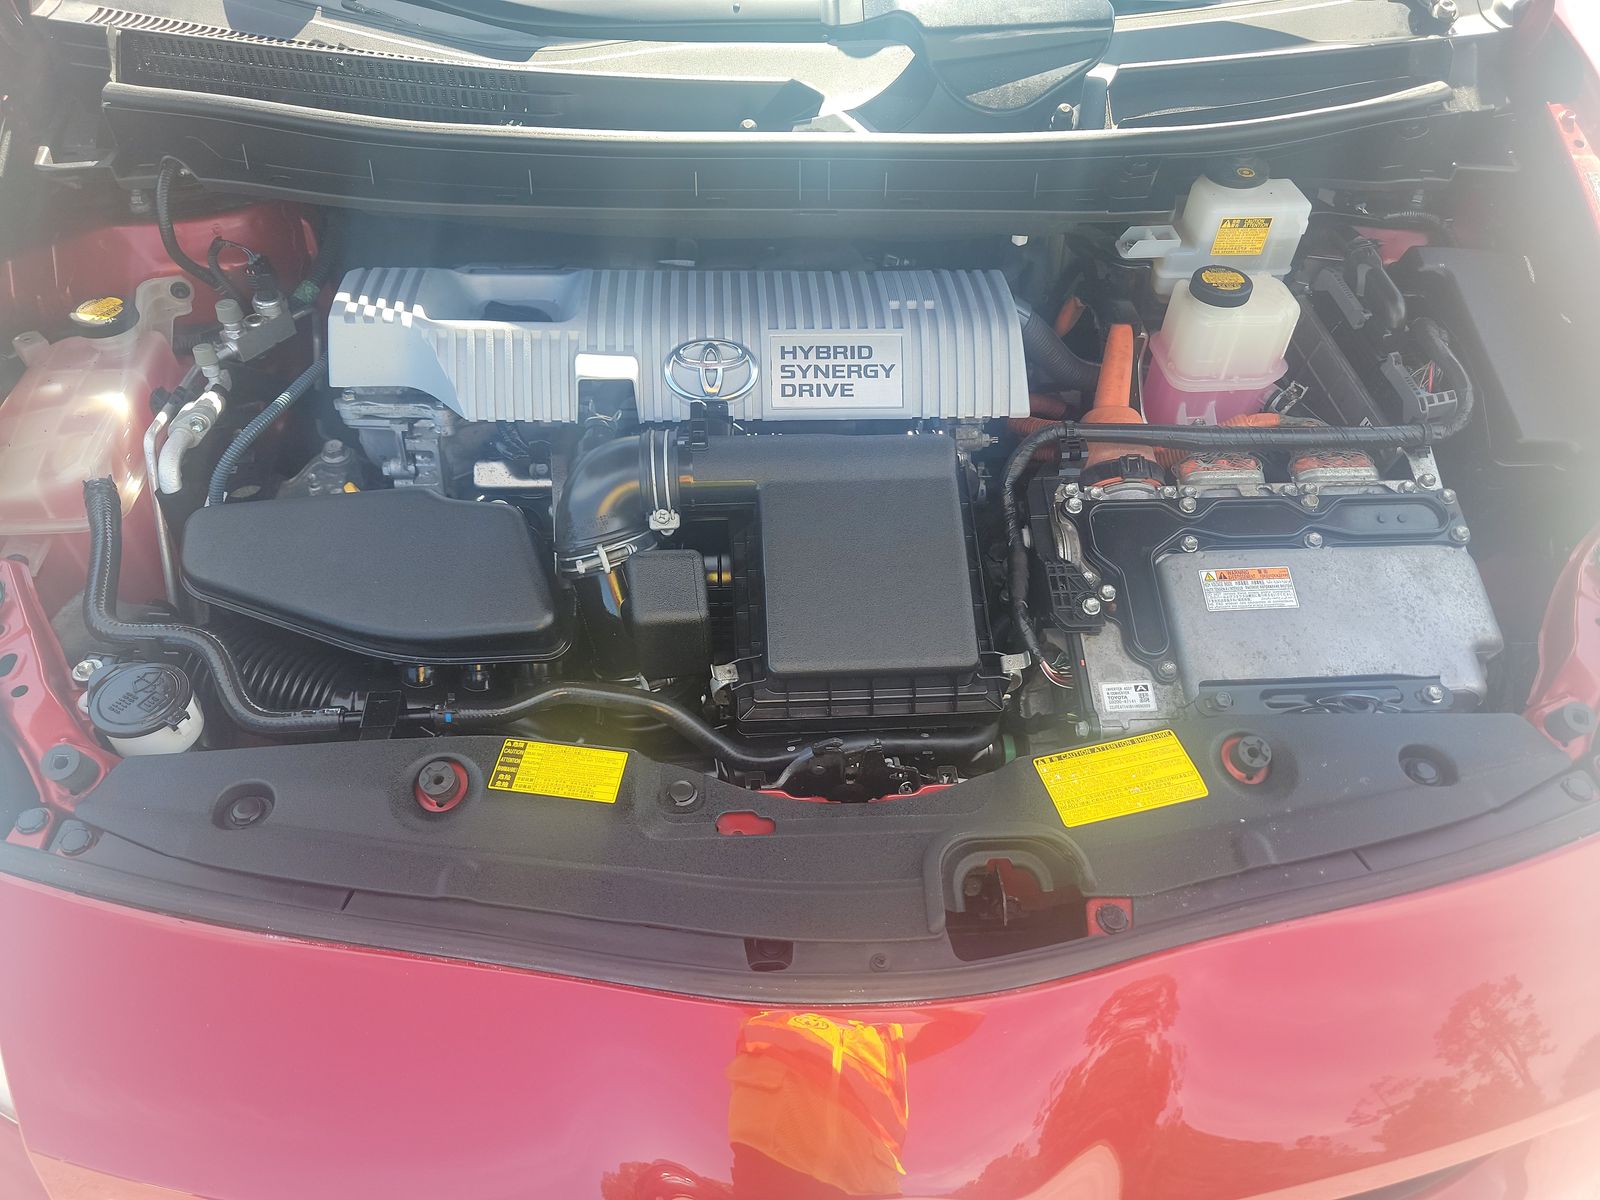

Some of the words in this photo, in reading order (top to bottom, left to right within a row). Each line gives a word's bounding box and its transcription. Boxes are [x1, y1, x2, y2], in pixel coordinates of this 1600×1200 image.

[780, 345, 873, 360] HYBRID
[780, 364, 896, 379] SYNERGY
[780, 383, 855, 397] DRIVE
[1061, 749, 1092, 759] CAUTION
[1094, 740, 1131, 752] ATTENTION
